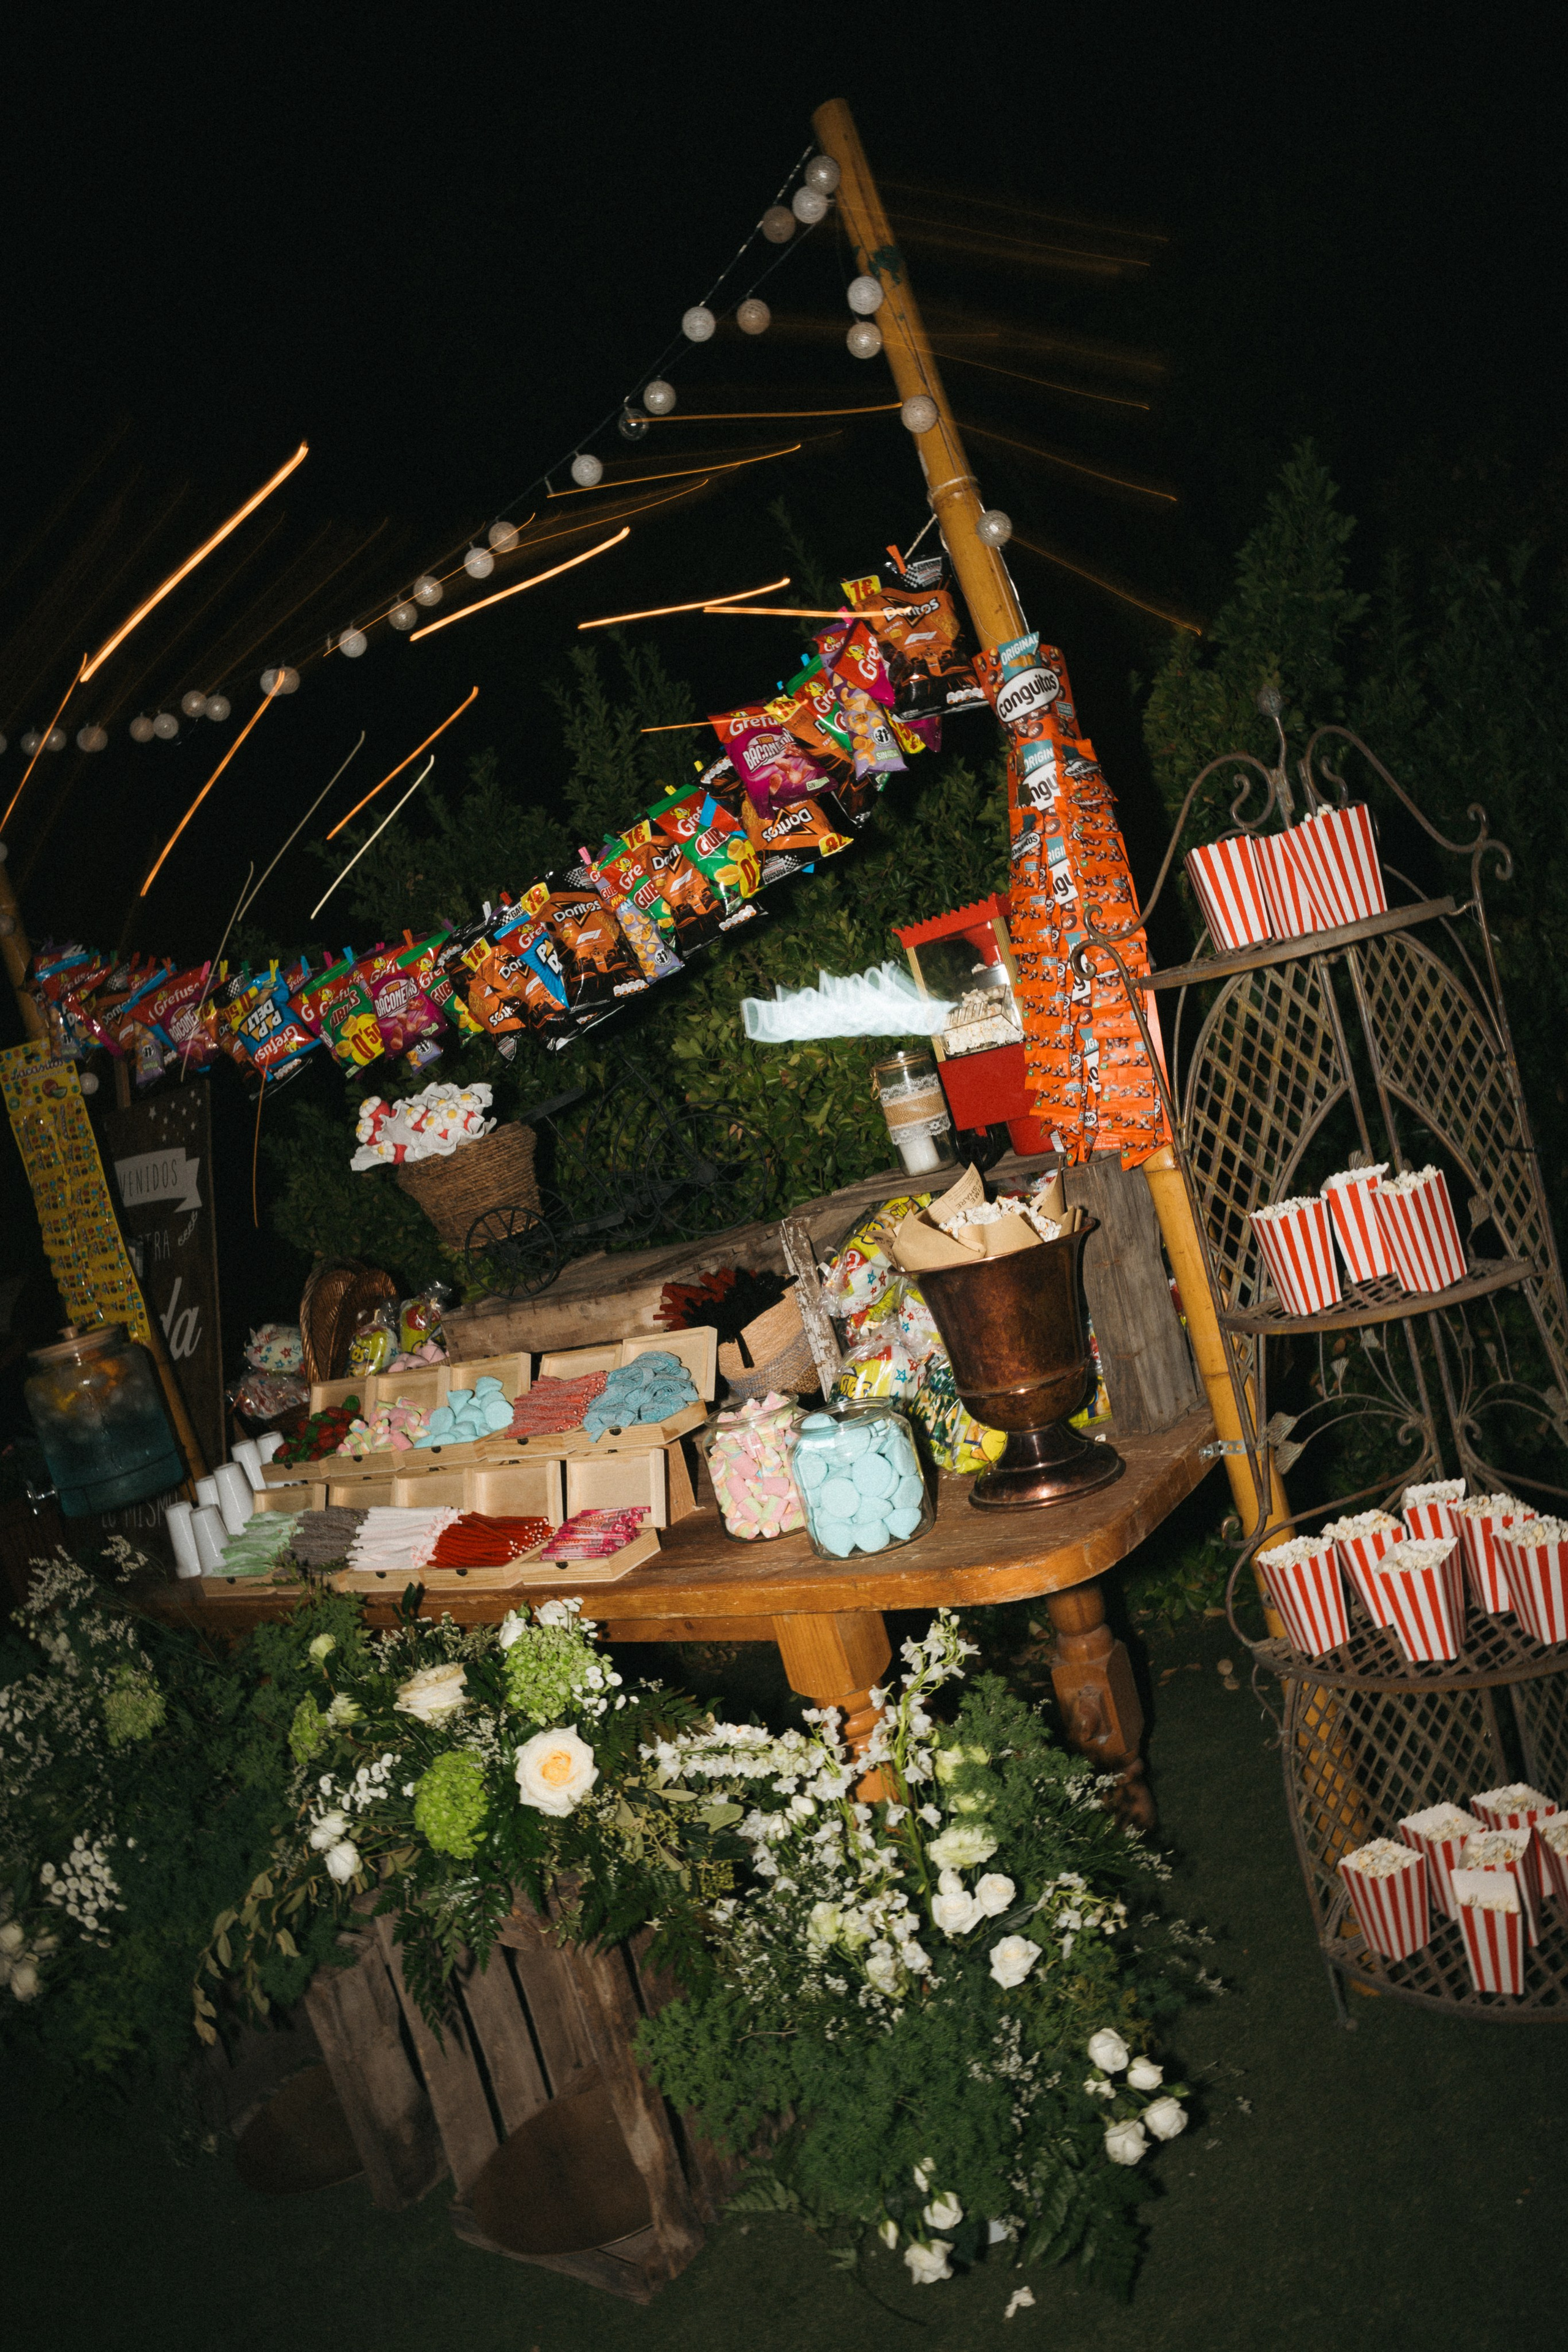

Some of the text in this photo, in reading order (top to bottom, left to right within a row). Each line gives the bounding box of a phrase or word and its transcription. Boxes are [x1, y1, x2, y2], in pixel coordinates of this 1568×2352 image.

[1001, 635, 1039, 666] ORIGINAL
[998, 673, 1057, 718] conguitos
[625, 824, 646, 849] 1€
[763, 808, 813, 842] Doritos
[554, 900, 602, 922] Doritos
[467, 943, 486, 967] 1€
[385, 981, 401, 993] TIRAS
[956, 1186, 978, 1210] SHARE
